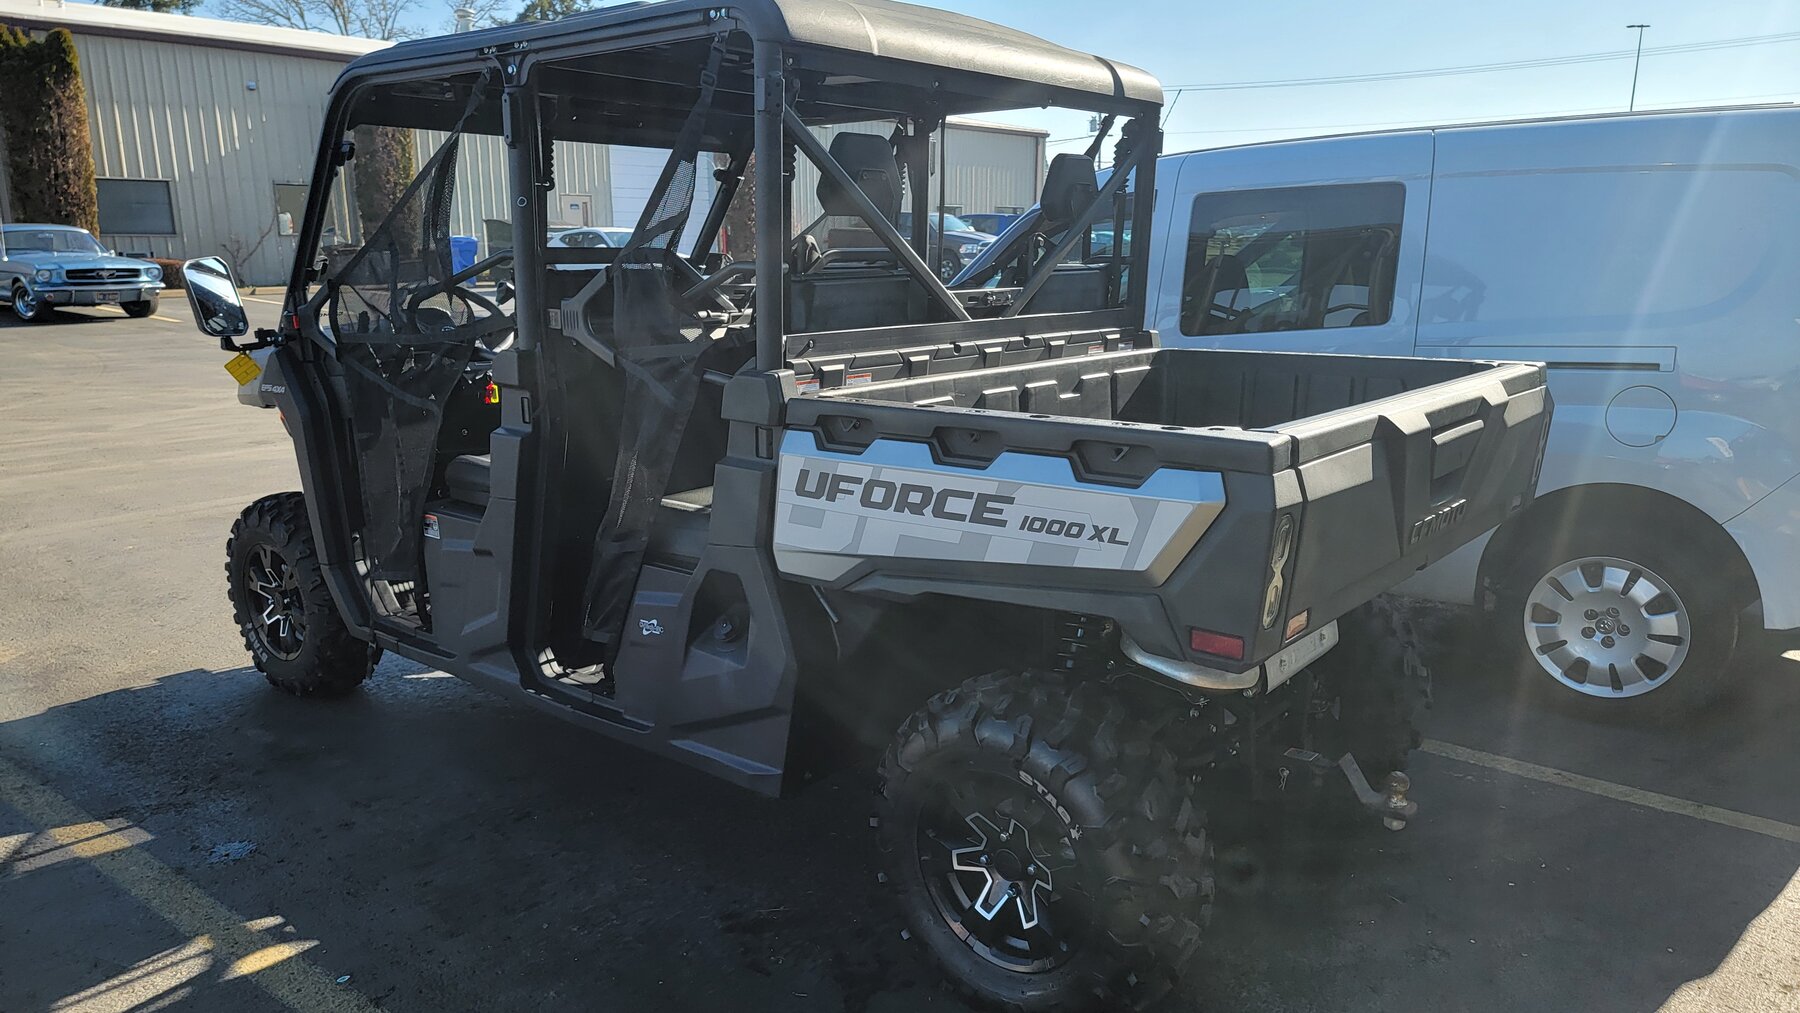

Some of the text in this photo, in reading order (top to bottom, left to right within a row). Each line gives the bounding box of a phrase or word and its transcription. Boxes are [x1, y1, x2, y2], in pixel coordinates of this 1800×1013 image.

[795, 469, 1129, 546] UFORCE 1000 XL
[1019, 770, 1071, 825] STAG
